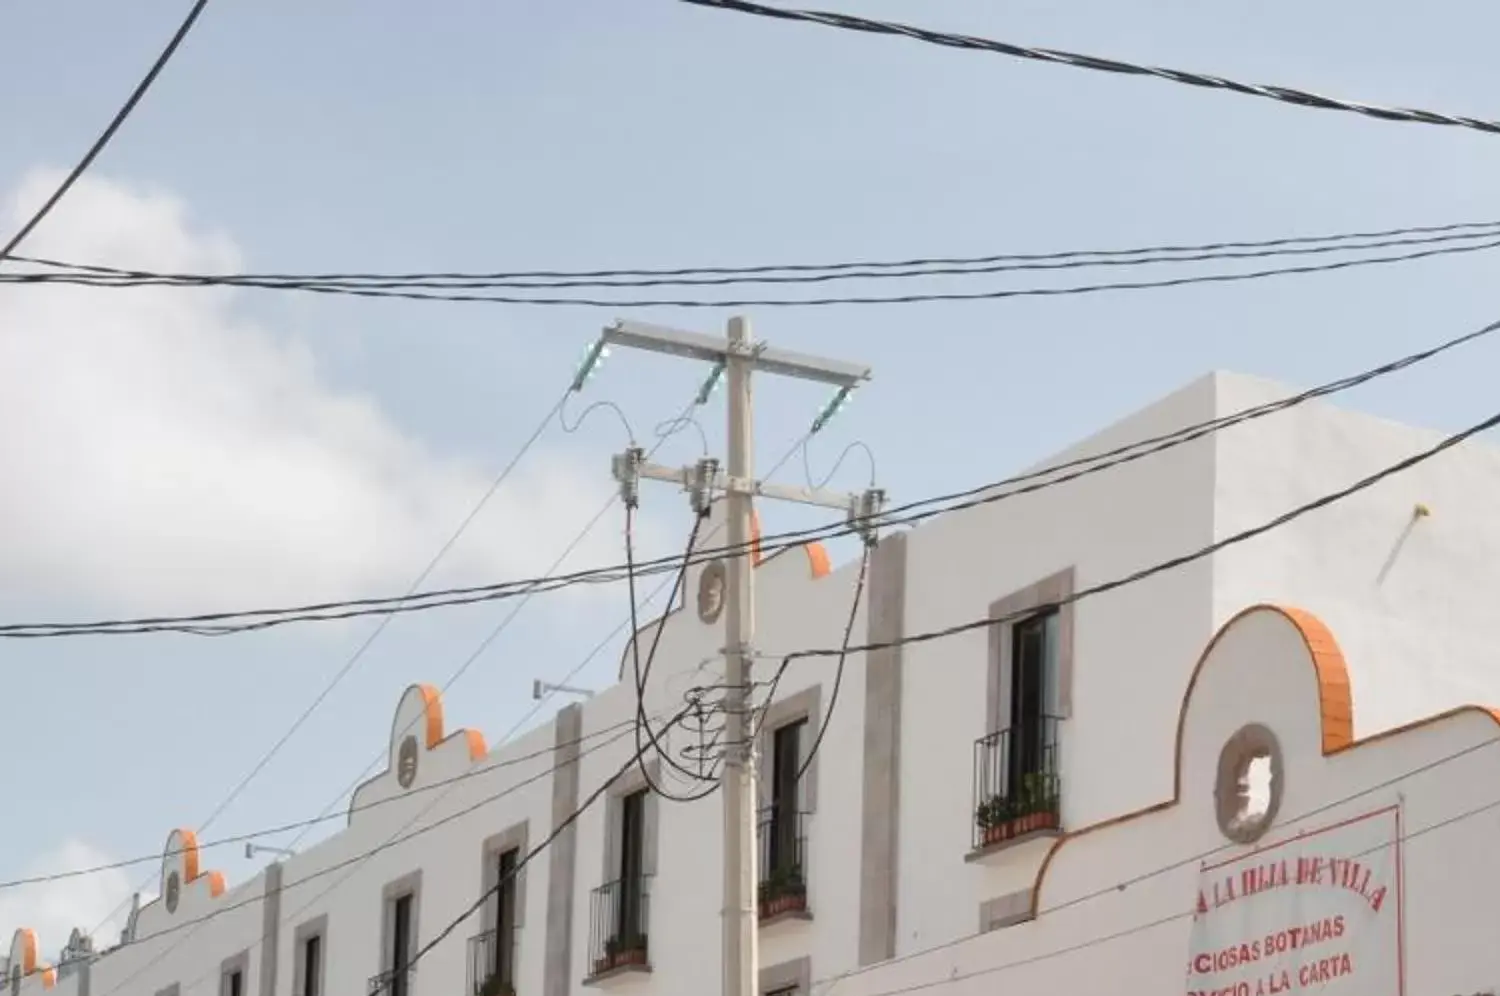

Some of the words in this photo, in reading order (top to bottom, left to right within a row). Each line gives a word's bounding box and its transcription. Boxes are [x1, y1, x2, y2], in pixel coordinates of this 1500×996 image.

[1329, 857, 1387, 912] VILLA
[1264, 915, 1345, 957] BOTANAS
[1269, 970, 1290, 995] LA
[1299, 953, 1352, 986] CARTA
